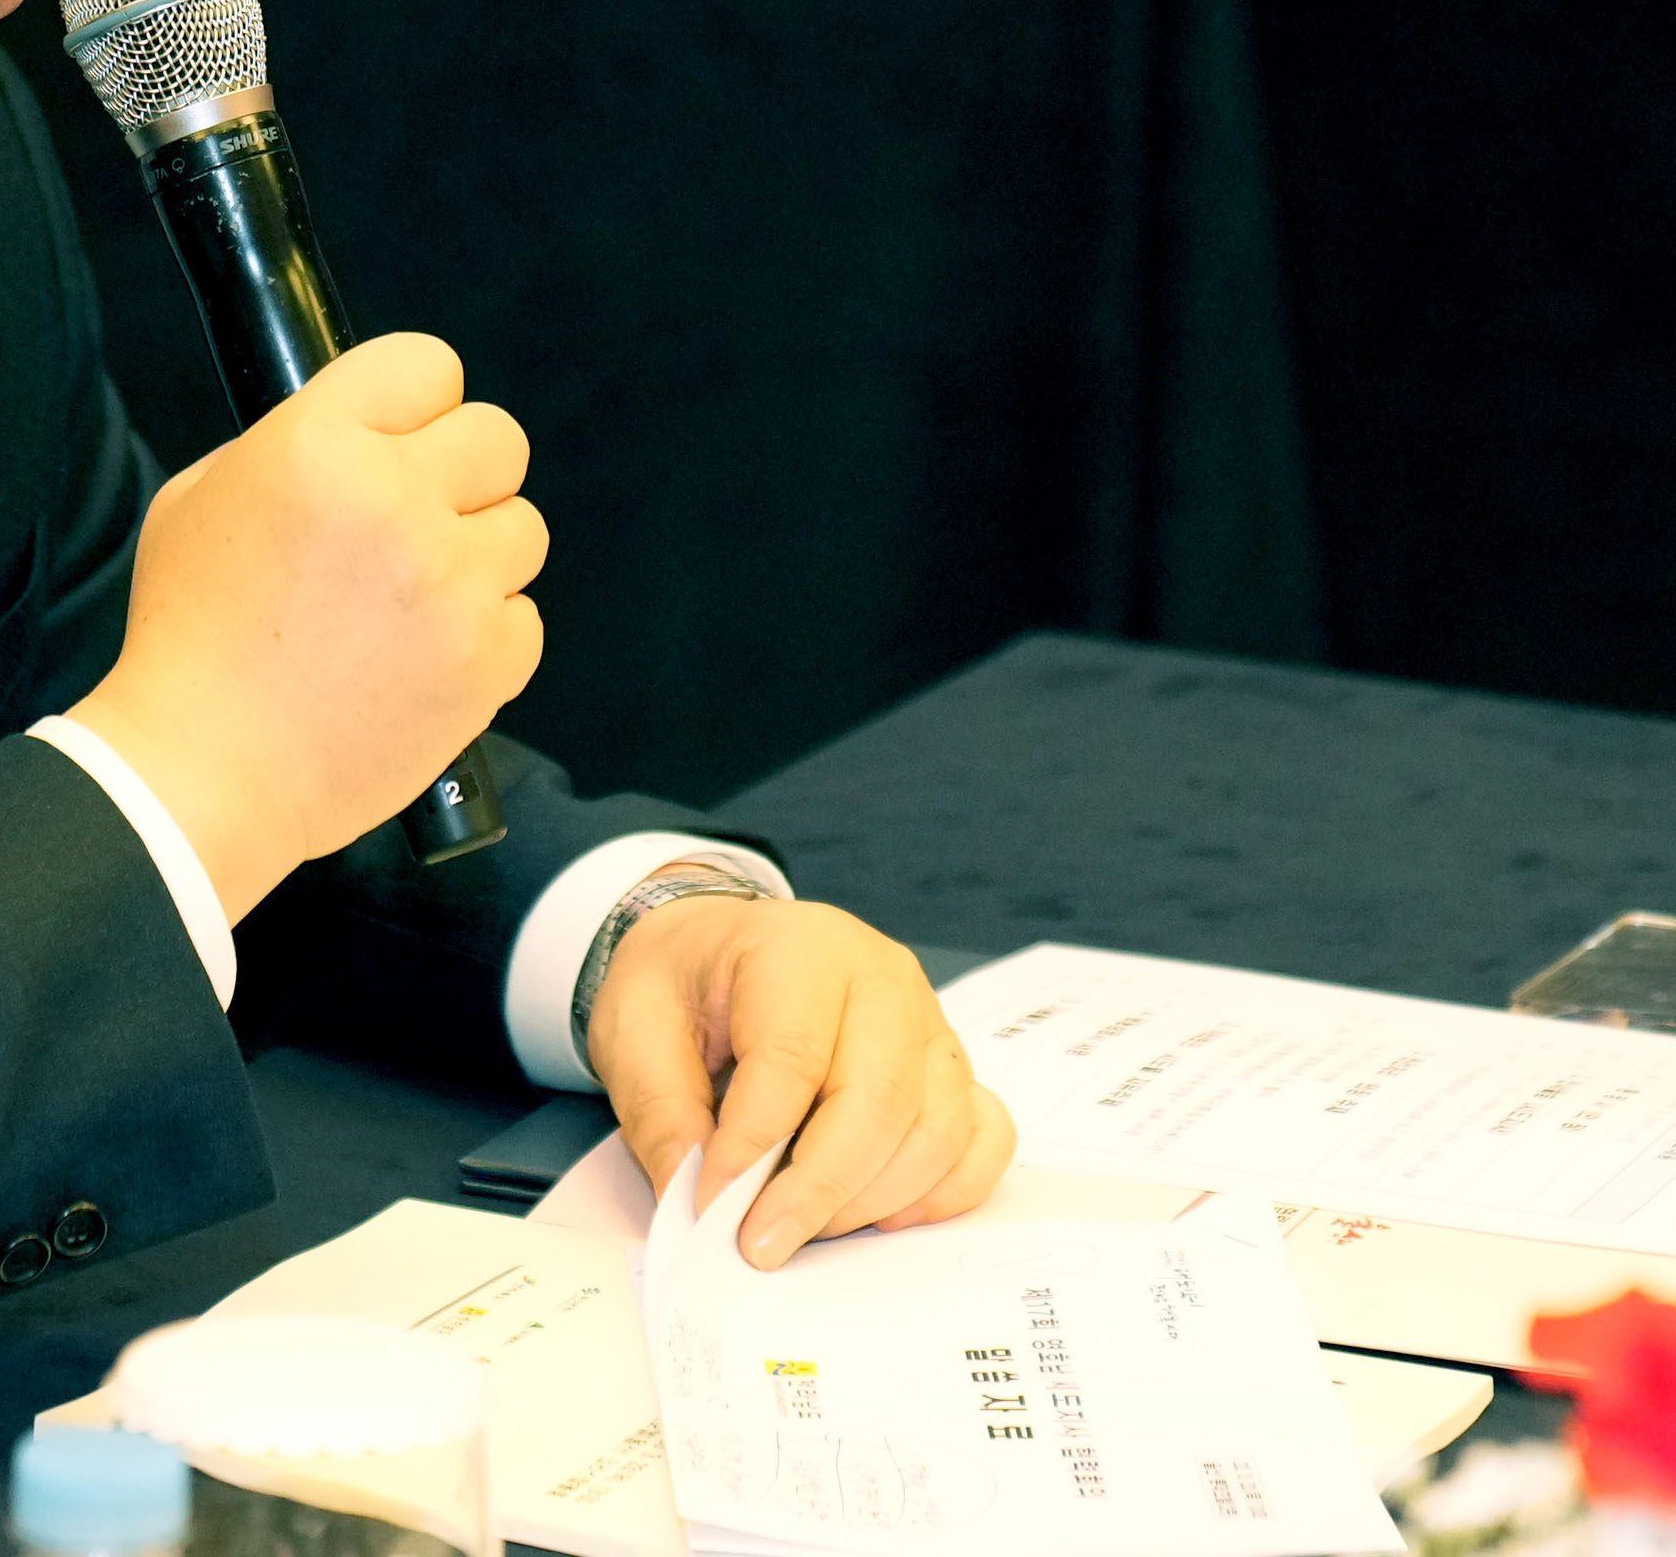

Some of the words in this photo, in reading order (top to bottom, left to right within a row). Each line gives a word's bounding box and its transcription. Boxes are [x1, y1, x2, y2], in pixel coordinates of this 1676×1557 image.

[219, 126, 279, 155] SHURE
[445, 781, 463, 806] 2
[1021, 1287, 1060, 1331] 제17회
[1032, 1339, 1075, 1375] 영호남
[1046, 1380, 1092, 1438] 시도지사
